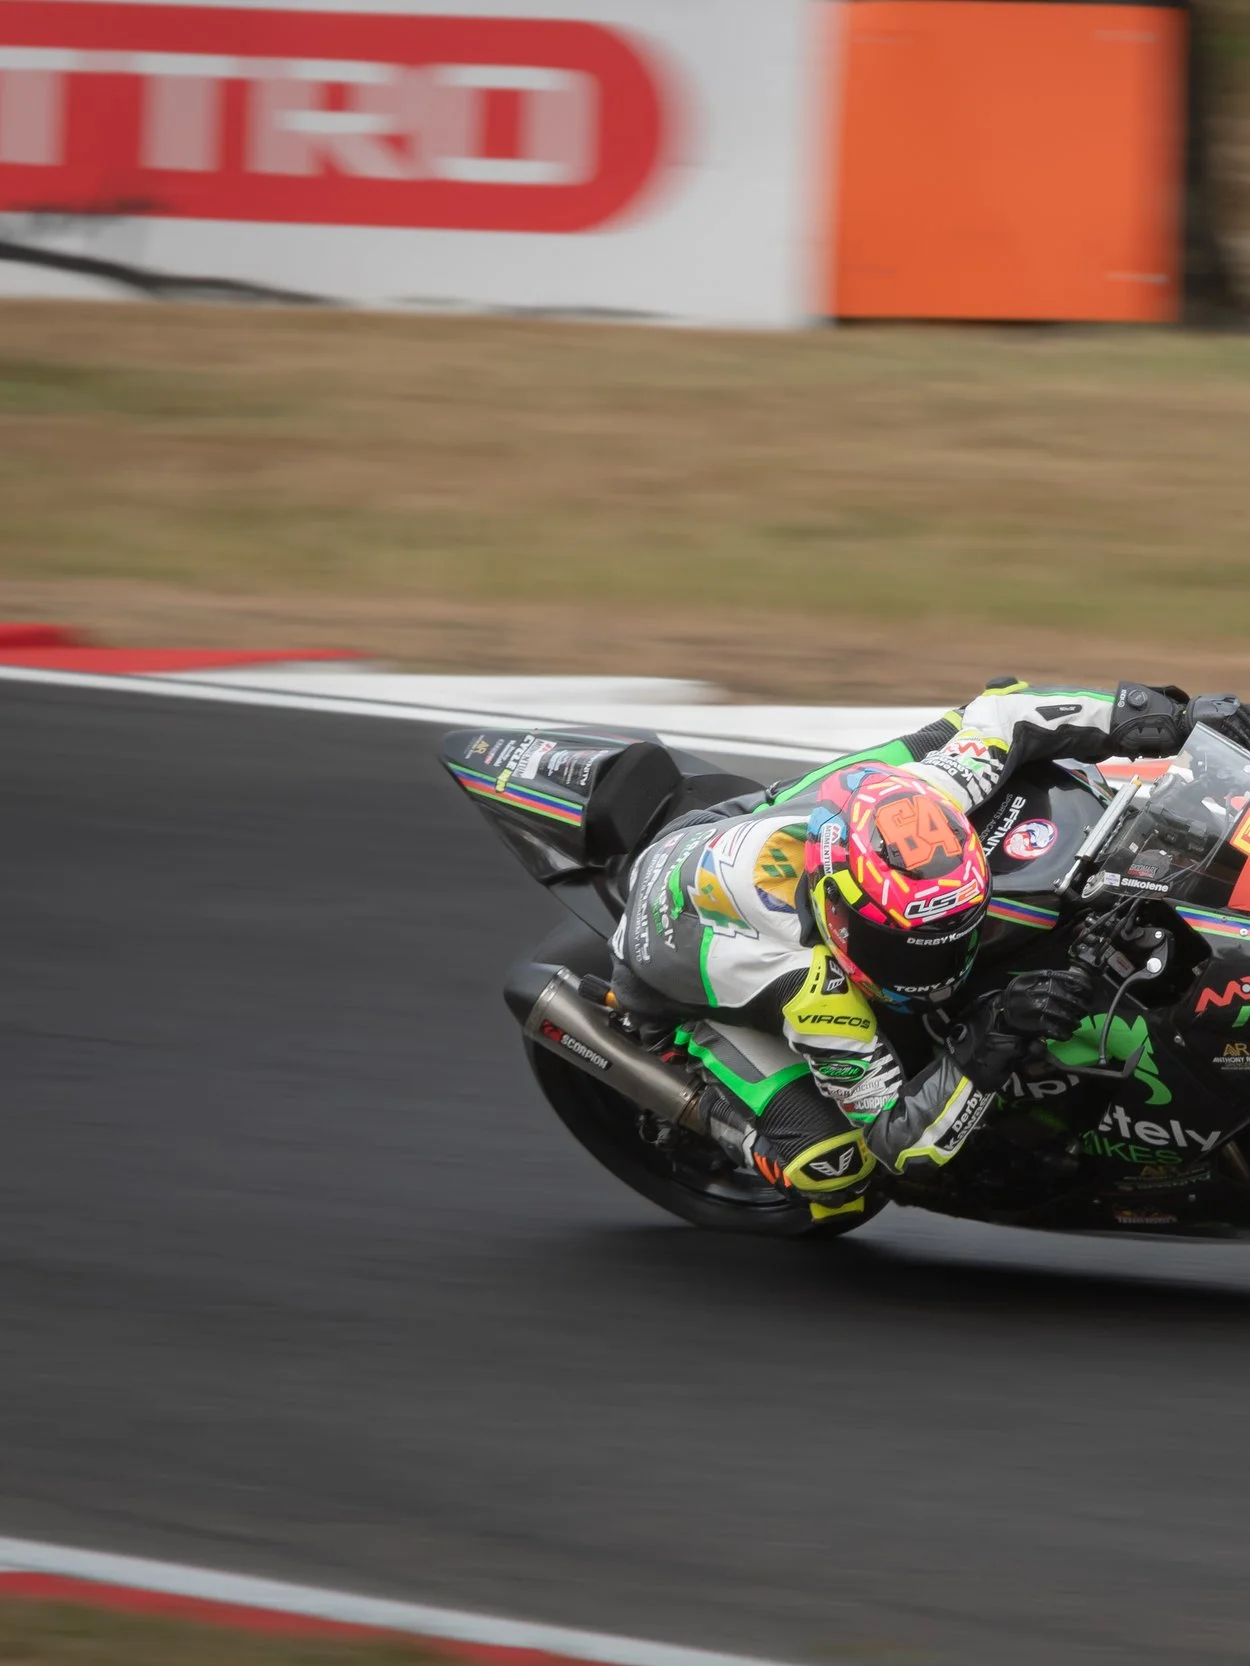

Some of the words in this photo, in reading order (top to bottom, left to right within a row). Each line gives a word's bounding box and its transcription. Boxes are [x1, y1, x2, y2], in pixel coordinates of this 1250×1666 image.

[875, 794, 963, 870] 64
[980, 817, 998, 842] ACADE
[983, 796, 1026, 857] AFFINIT
[825, 824, 833, 875] MOMENTUM
[1120, 877, 1169, 893] Silkolene
[907, 933, 949, 946] DERBY
[895, 984, 939, 993] TONY
[797, 1013, 871, 1030] VIRCOS
[561, 1033, 608, 1070] SCORPION
[854, 1095, 896, 1111] SCORPIO
[952, 1090, 983, 1133] Derby
